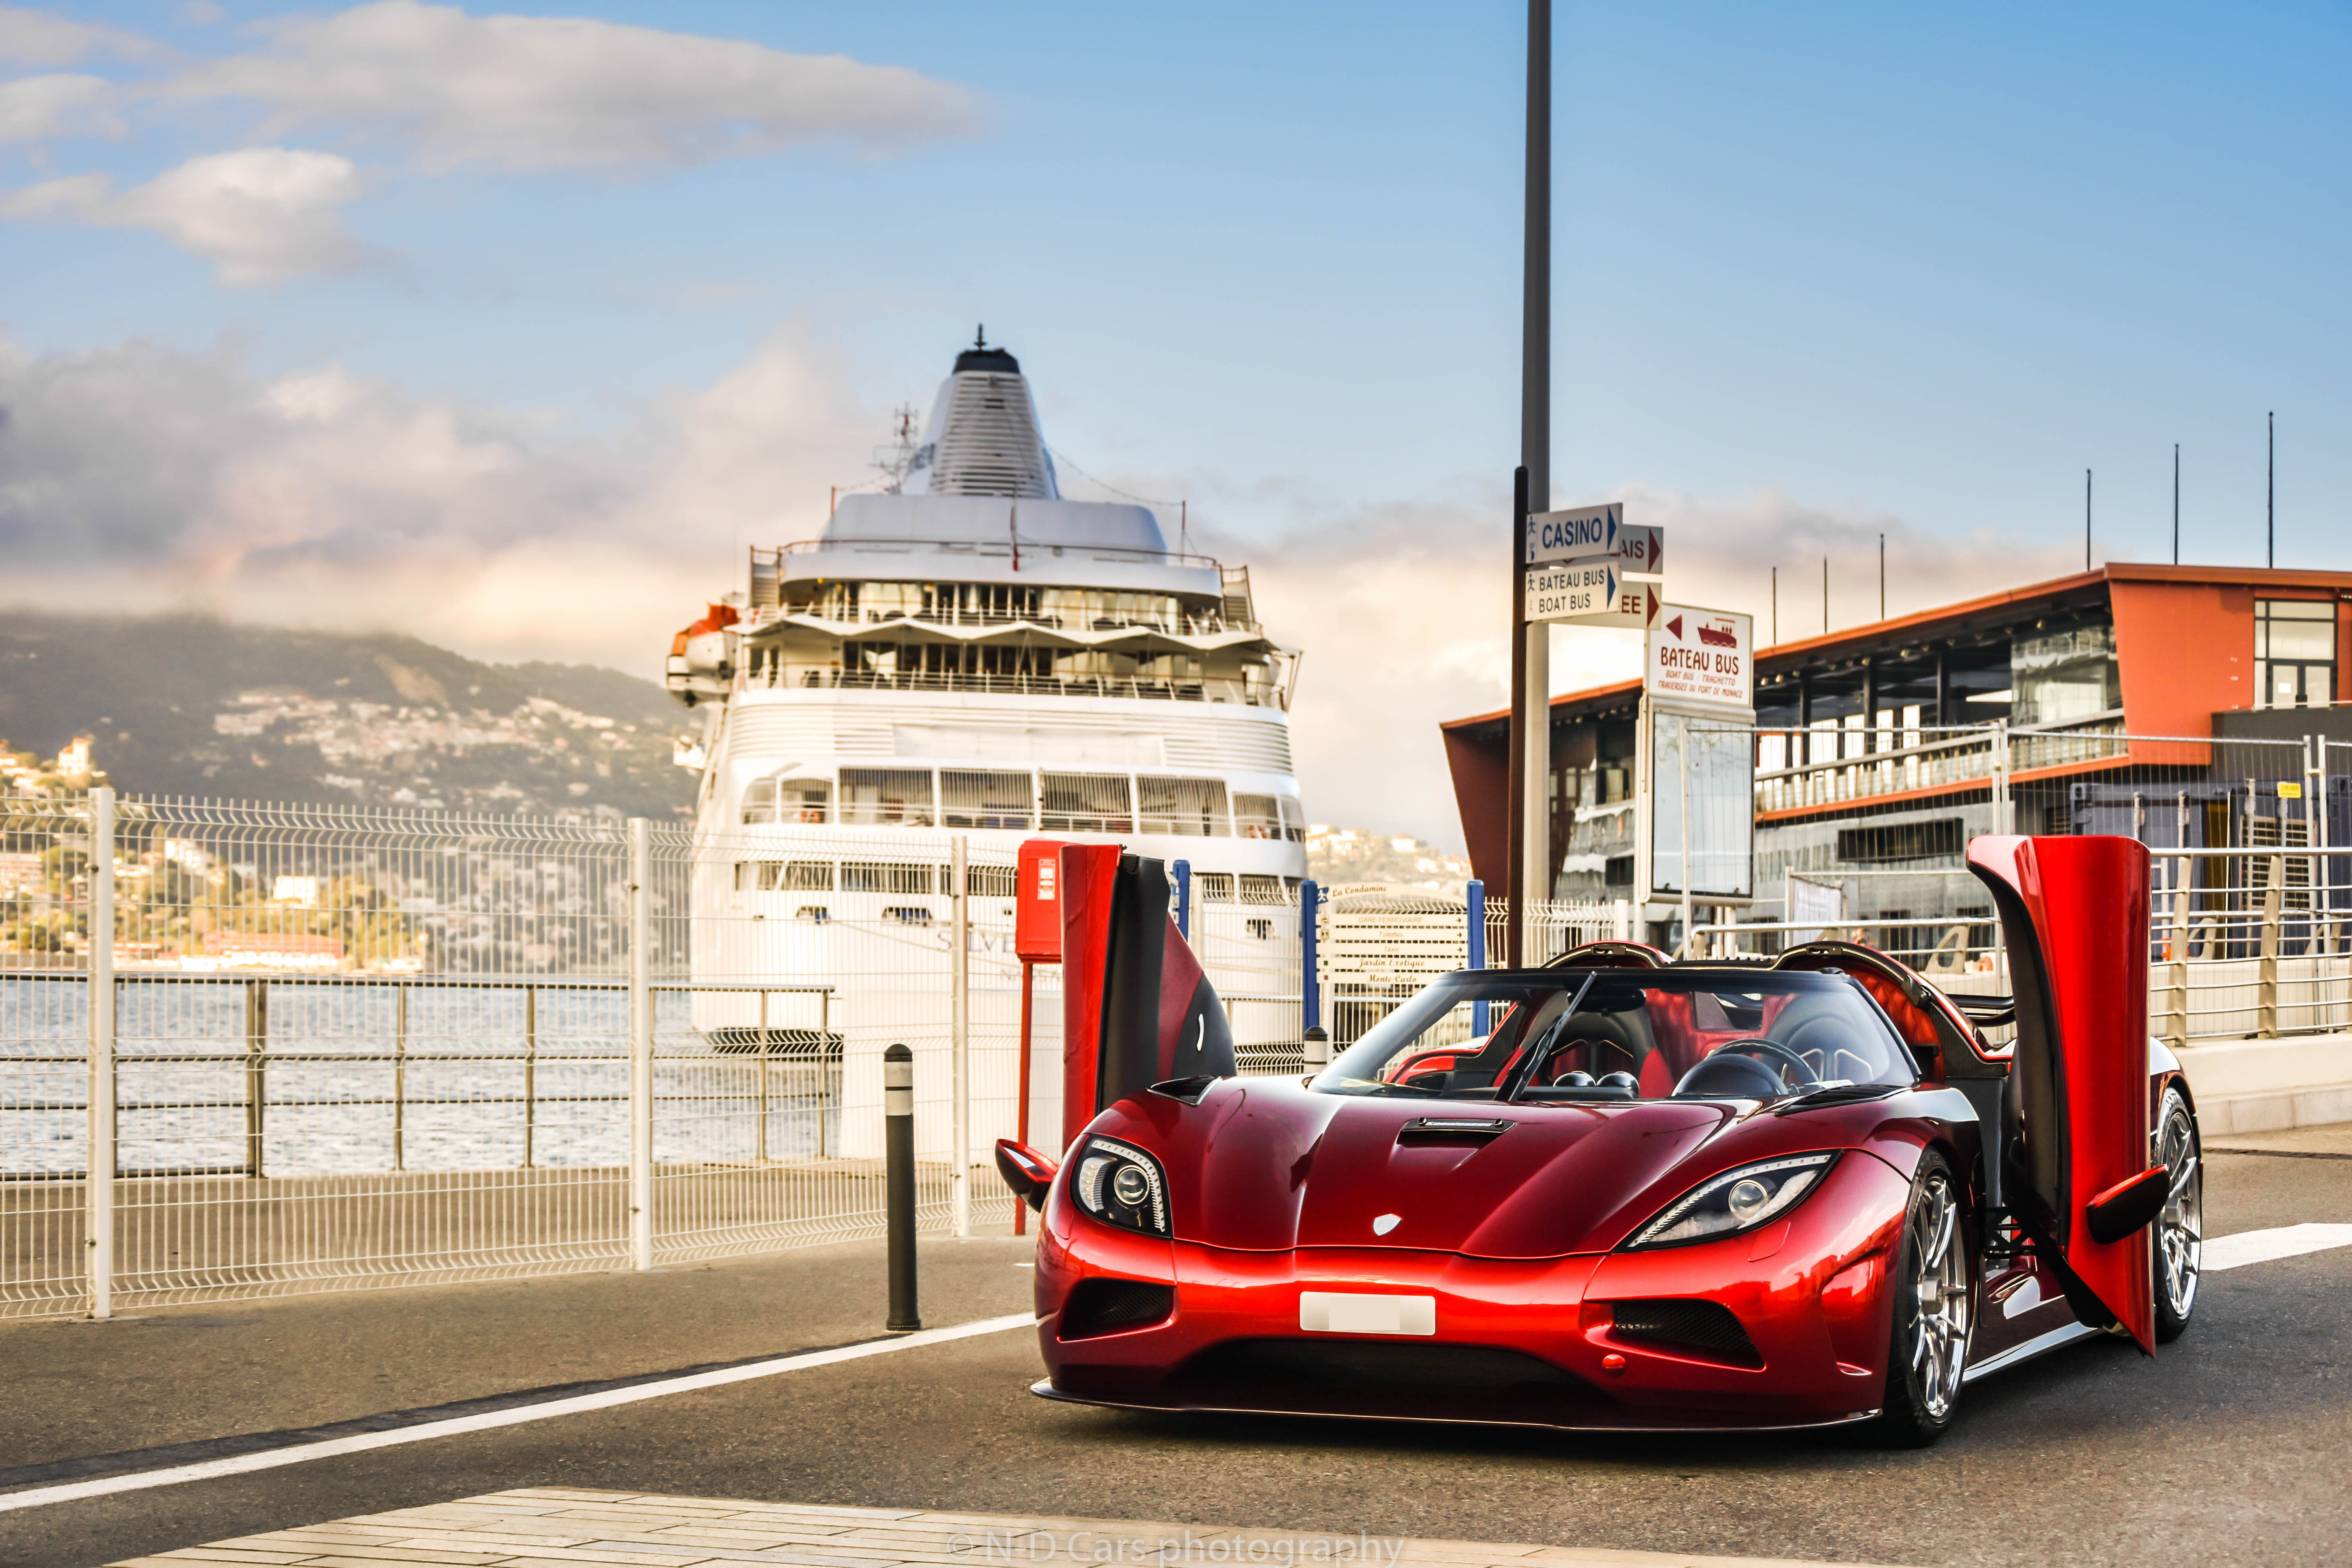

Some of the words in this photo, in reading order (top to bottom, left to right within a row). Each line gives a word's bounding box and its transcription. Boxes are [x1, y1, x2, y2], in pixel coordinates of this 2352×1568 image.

[1542, 517, 1602, 549] CASINO
[1539, 573, 1580, 591] BATEAU
[1584, 569, 1604, 587] BUS
[1539, 596, 1566, 613] BOAT
[1570, 593, 1590, 610] BUS
[1661, 646, 1709, 671] BATEAU
[1716, 654, 1739, 675] BUS
[1666, 670, 1681, 679] BOAT
[1683, 672, 1694, 680] BUS
[1689, 684, 1696, 692] DU
[1698, 685, 1712, 694] PORT
[1722, 689, 1743, 698] MONACO
[1345, 884, 1387, 894] Condamine
[1359, 959, 1385, 968] Jardin
[1389, 959, 1425, 968] Exotique
